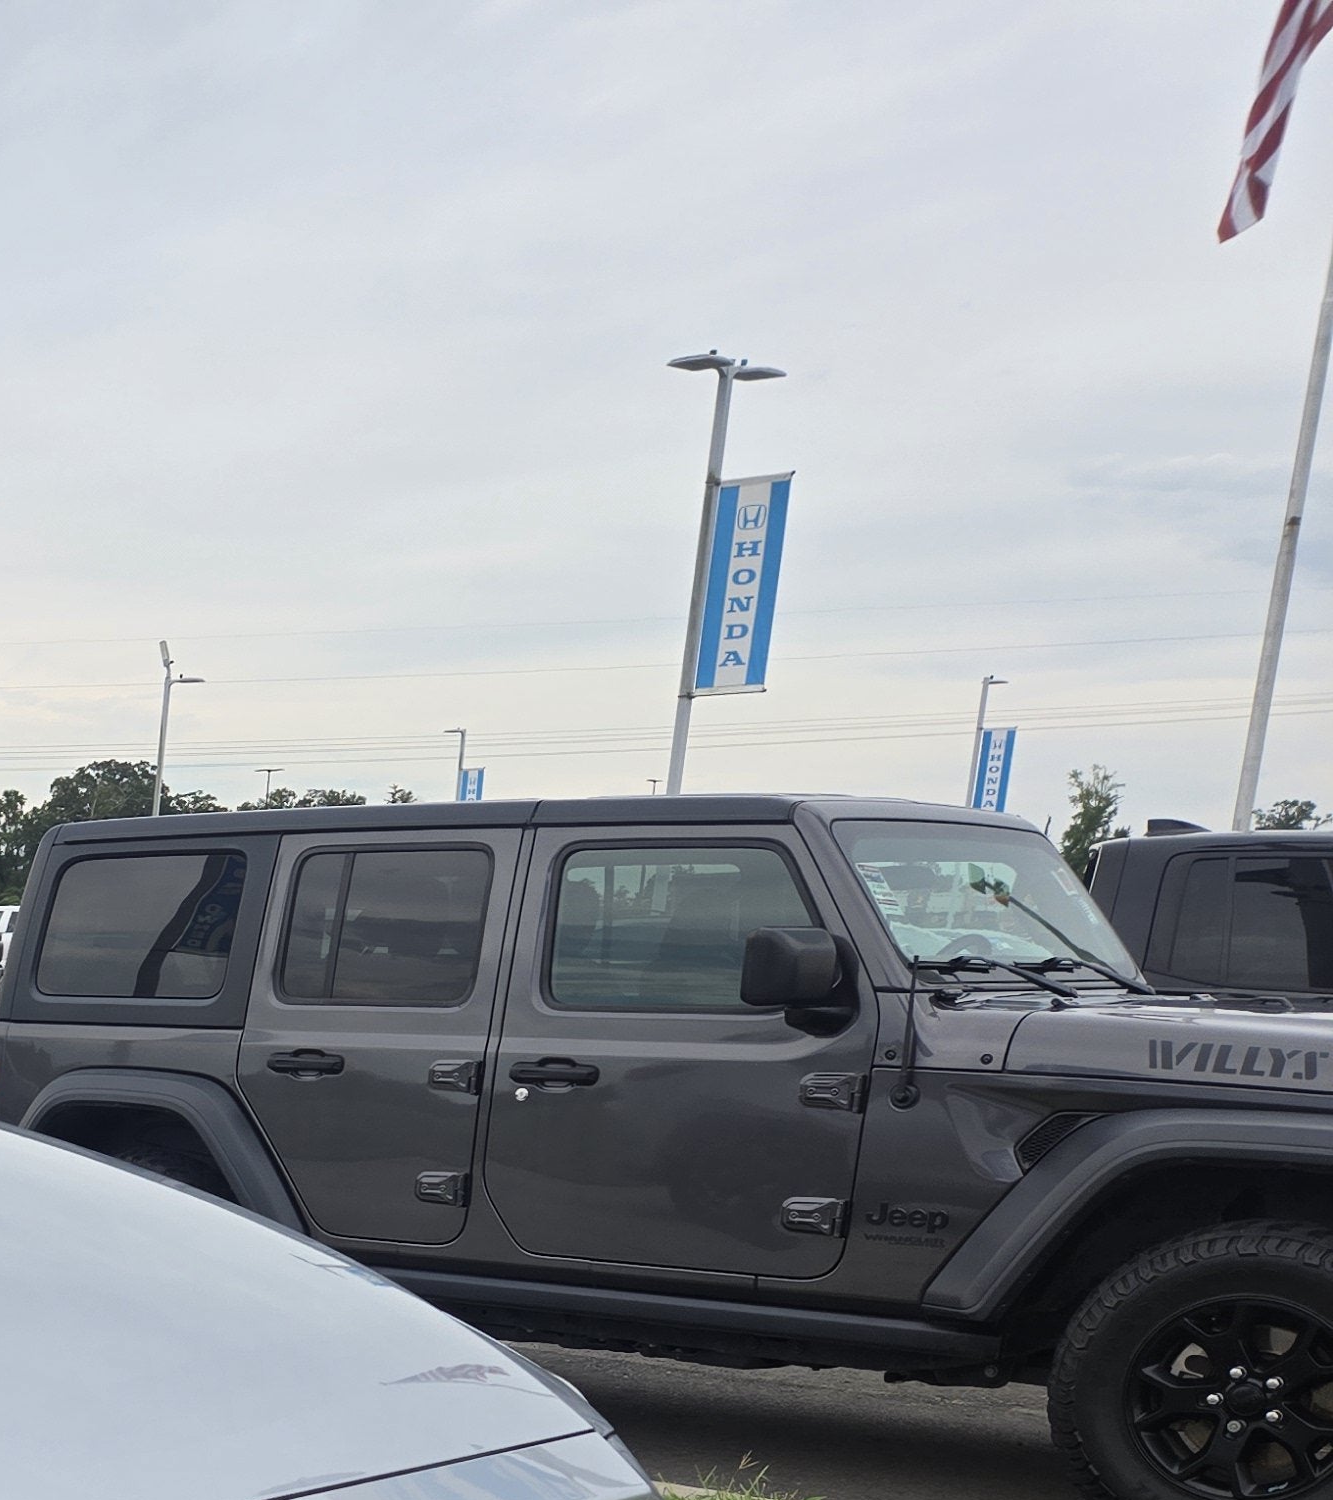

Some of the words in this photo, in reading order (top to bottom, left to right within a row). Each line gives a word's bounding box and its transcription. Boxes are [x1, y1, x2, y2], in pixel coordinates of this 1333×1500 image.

[719, 540, 762, 667] HONDA
[983, 754, 1002, 807] HONDA
[1149, 1039, 1330, 1081] WILLYS
[864, 1202, 949, 1233] Jeep
